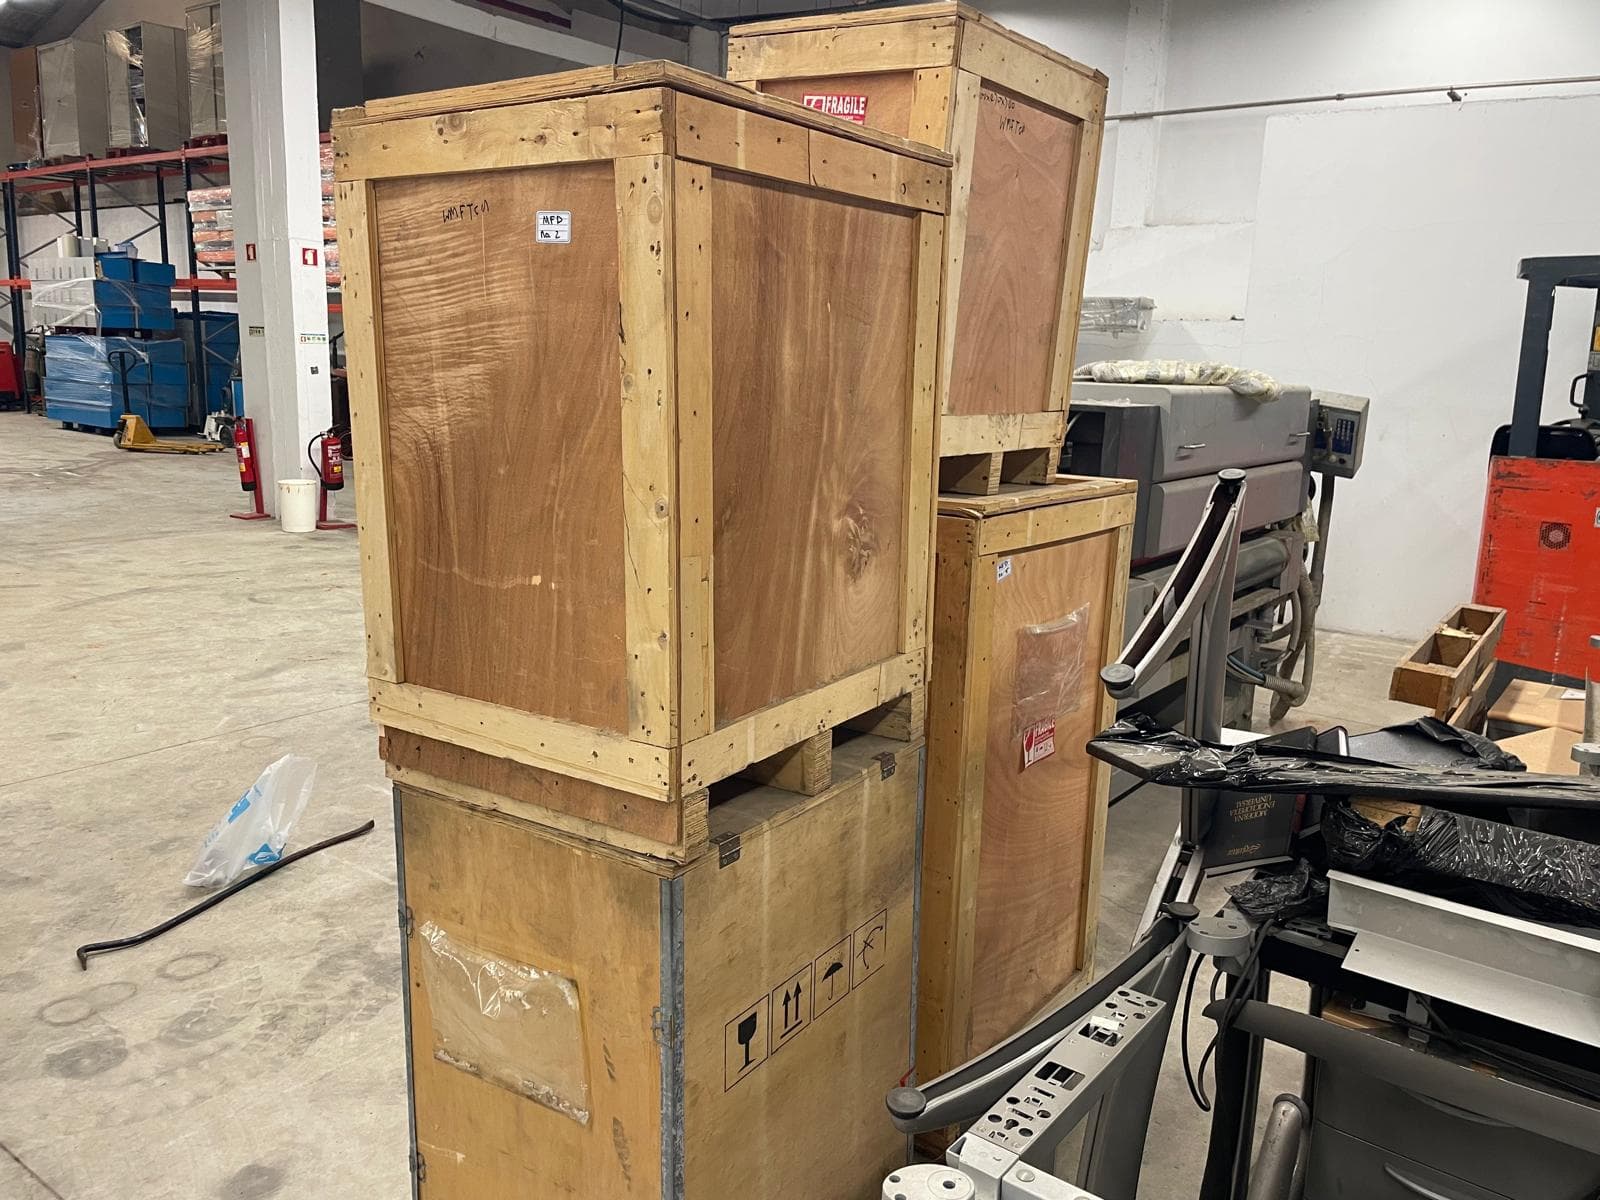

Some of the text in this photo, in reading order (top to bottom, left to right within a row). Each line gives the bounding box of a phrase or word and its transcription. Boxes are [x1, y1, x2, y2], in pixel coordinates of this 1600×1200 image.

[826, 96, 866, 114] FRAGILE
[542, 215, 563, 225] MFD
[554, 230, 561, 239] 2
[1235, 793, 1272, 809] UNIVERSAL
[1234, 809, 1268, 823] MODERNA
